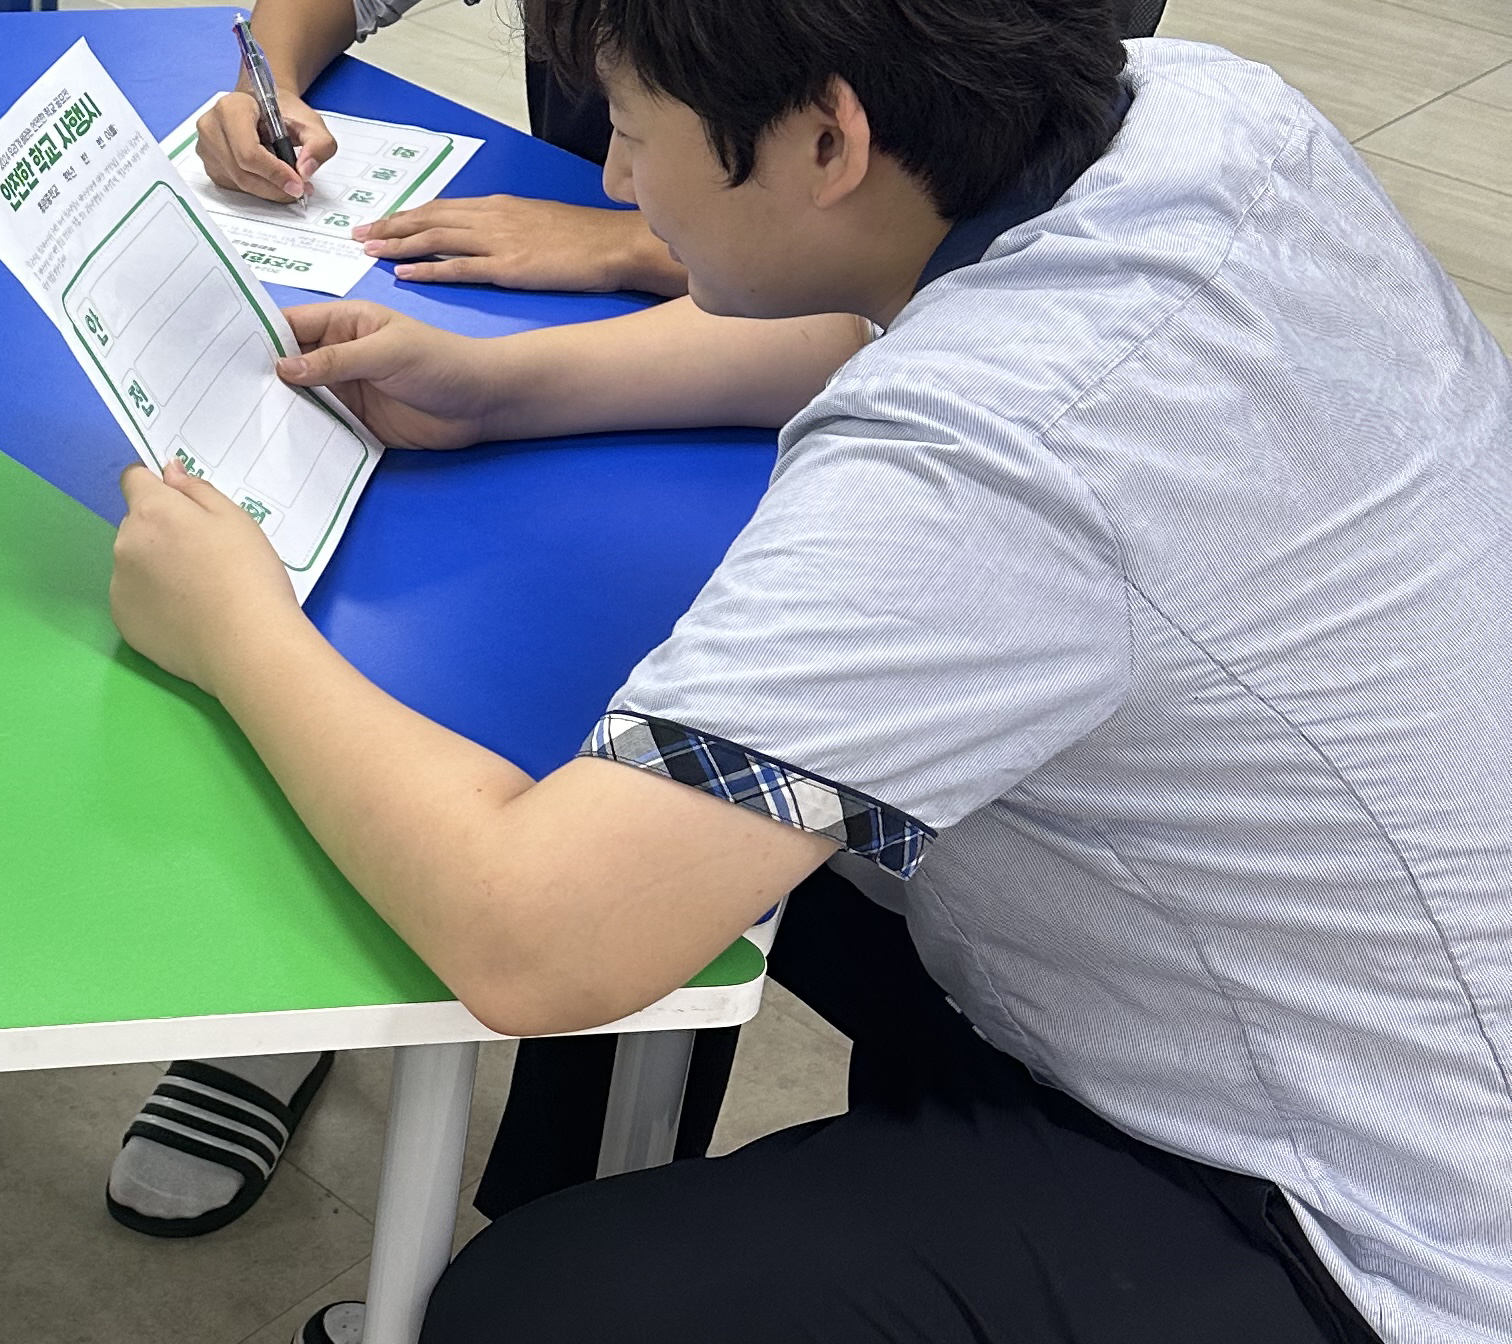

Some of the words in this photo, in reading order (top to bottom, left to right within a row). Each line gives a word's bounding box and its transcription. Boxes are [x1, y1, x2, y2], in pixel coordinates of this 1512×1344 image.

[0, 157, 39, 212] 안전한
[28, 133, 62, 173] 학교
[53, 92, 102, 149] 사행시
[348, 190, 373, 203] 전
[324, 213, 349, 226] 안
[241, 251, 312, 271] 안전한
[85, 308, 108, 346] 안
[128, 380, 154, 417] 전
